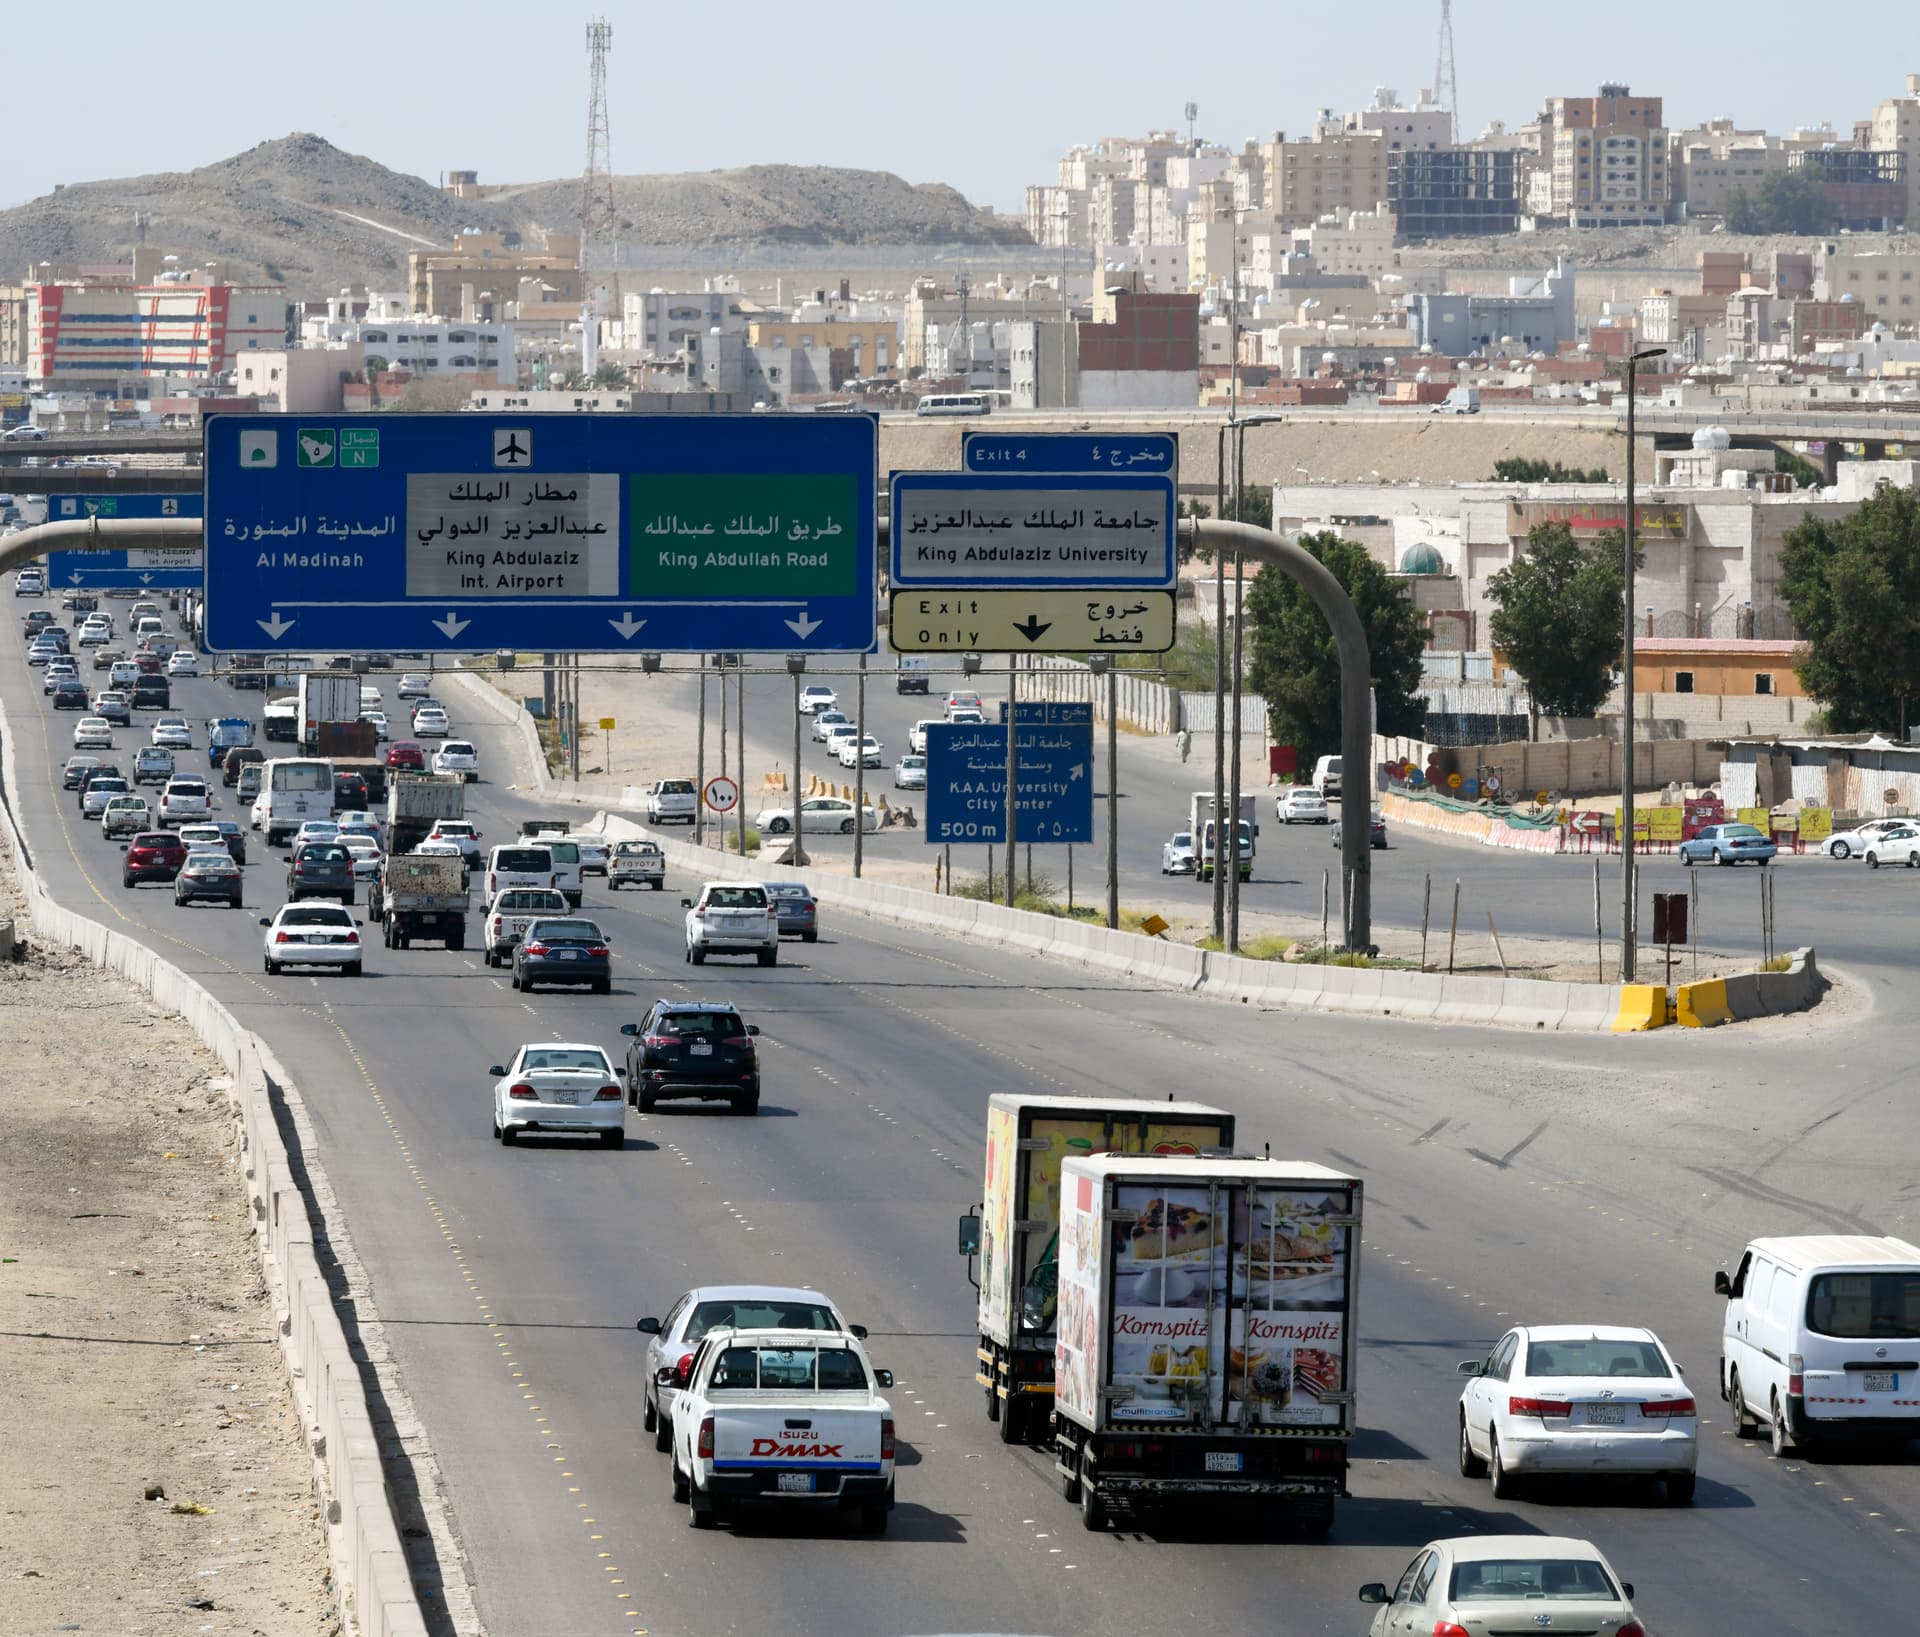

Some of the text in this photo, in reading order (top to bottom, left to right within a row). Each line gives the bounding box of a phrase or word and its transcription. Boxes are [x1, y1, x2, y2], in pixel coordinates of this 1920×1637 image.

[343, 431, 376, 446] شمال
[314, 448, 319, 456] ٥
[354, 451, 364, 464] N
[976, 449, 1026, 460] Exit 4
[1093, 446, 1164, 466] مخرج ٤
[449, 482, 577, 505] مطار الملك
[225, 516, 395, 540] المدينة المنورة
[645, 515, 842, 540] طريق الملك عبدالله
[908, 510, 1158, 533] جامعة الملك عبدالعزيز
[418, 515, 606, 546] عبدالعزيز الدولي
[257, 553, 363, 567] Al Madinah
[447, 551, 578, 568] King Abdulaziz
[659, 552, 827, 569] King Abdullah Road
[918, 547, 1148, 564] King Abdulaziz University
[462, 574, 564, 591] Int. Airport
[920, 601, 977, 614] Exit
[1087, 601, 1148, 621] خروج
[919, 630, 979, 645] Only
[1093, 626, 1143, 643] فقط
[1035, 708, 1043, 718] 4
[948, 734, 1001, 751] عبدالعزيز
[1039, 736, 1072, 750] جامعة
[1018, 756, 1052, 773] وسط
[992, 782, 1067, 796] Unversity
[967, 798, 997, 812] City
[941, 823, 997, 837] 500 m
[1037, 822, 1077, 836] ٥٠٠ م
[1115, 1313, 1208, 1340] Kornspitz
[1248, 1317, 1339, 1343] Kornspitz
[779, 1431, 818, 1440] ISUZU
